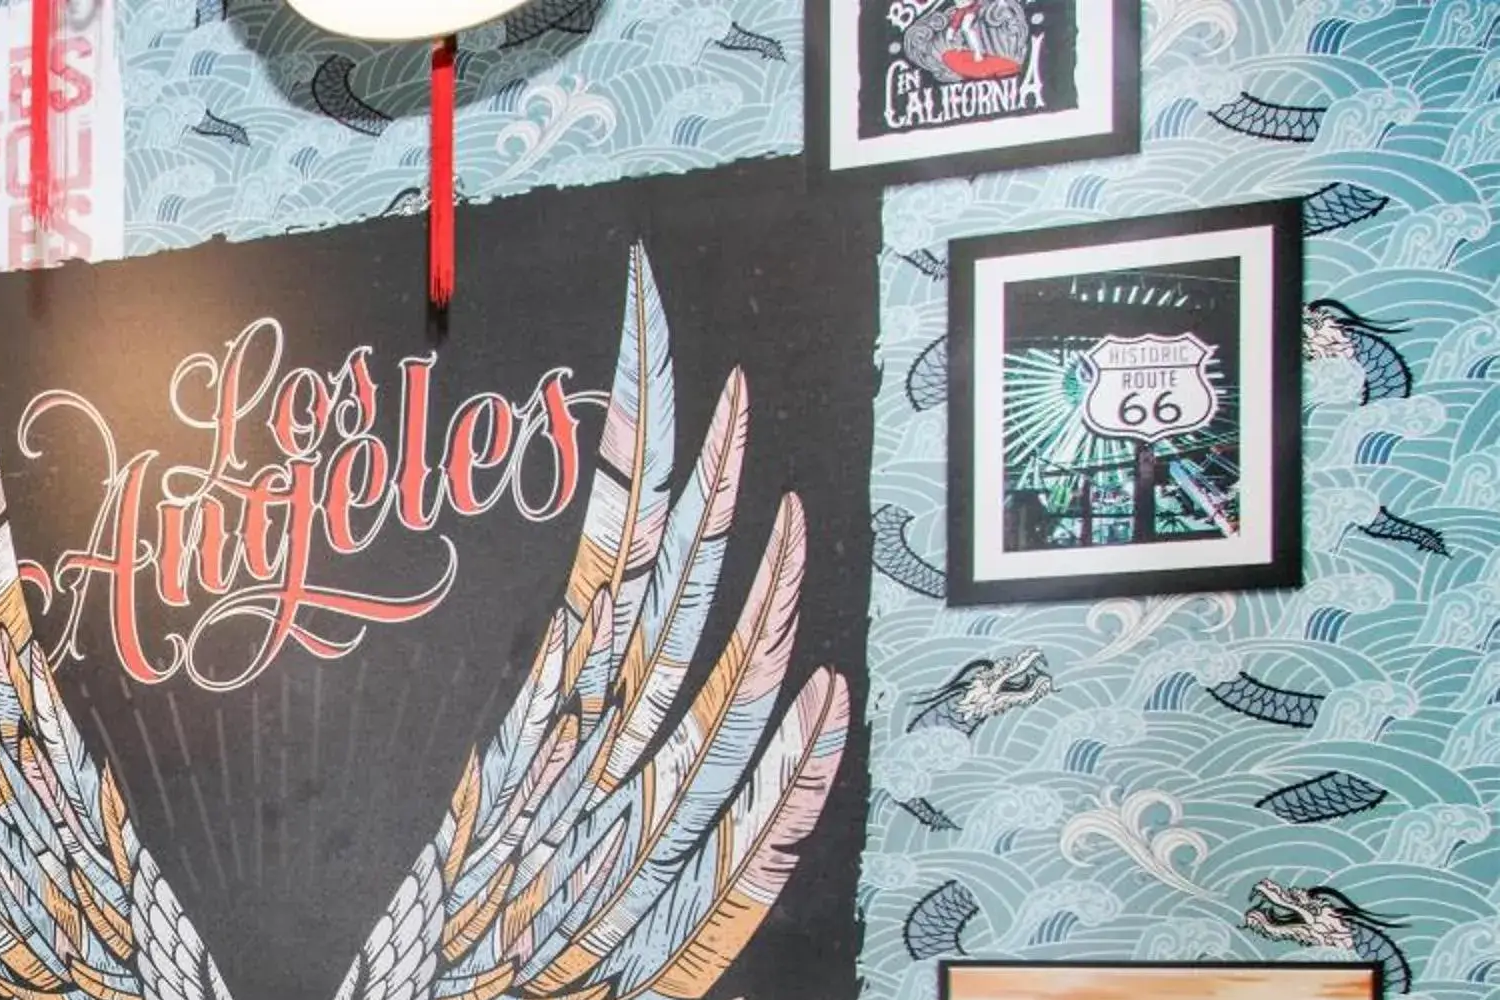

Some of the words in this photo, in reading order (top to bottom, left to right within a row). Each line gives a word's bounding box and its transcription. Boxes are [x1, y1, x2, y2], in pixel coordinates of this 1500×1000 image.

[884, 33, 1045, 128] CALIFORNIA
[897, 67, 920, 95] IN
[1108, 346, 1192, 364] HISTORIC
[1122, 370, 1181, 390] ROUTE
[164, 317, 375, 500] Los
[1118, 391, 1183, 427] 66
[18, 350, 610, 692] Angeles
